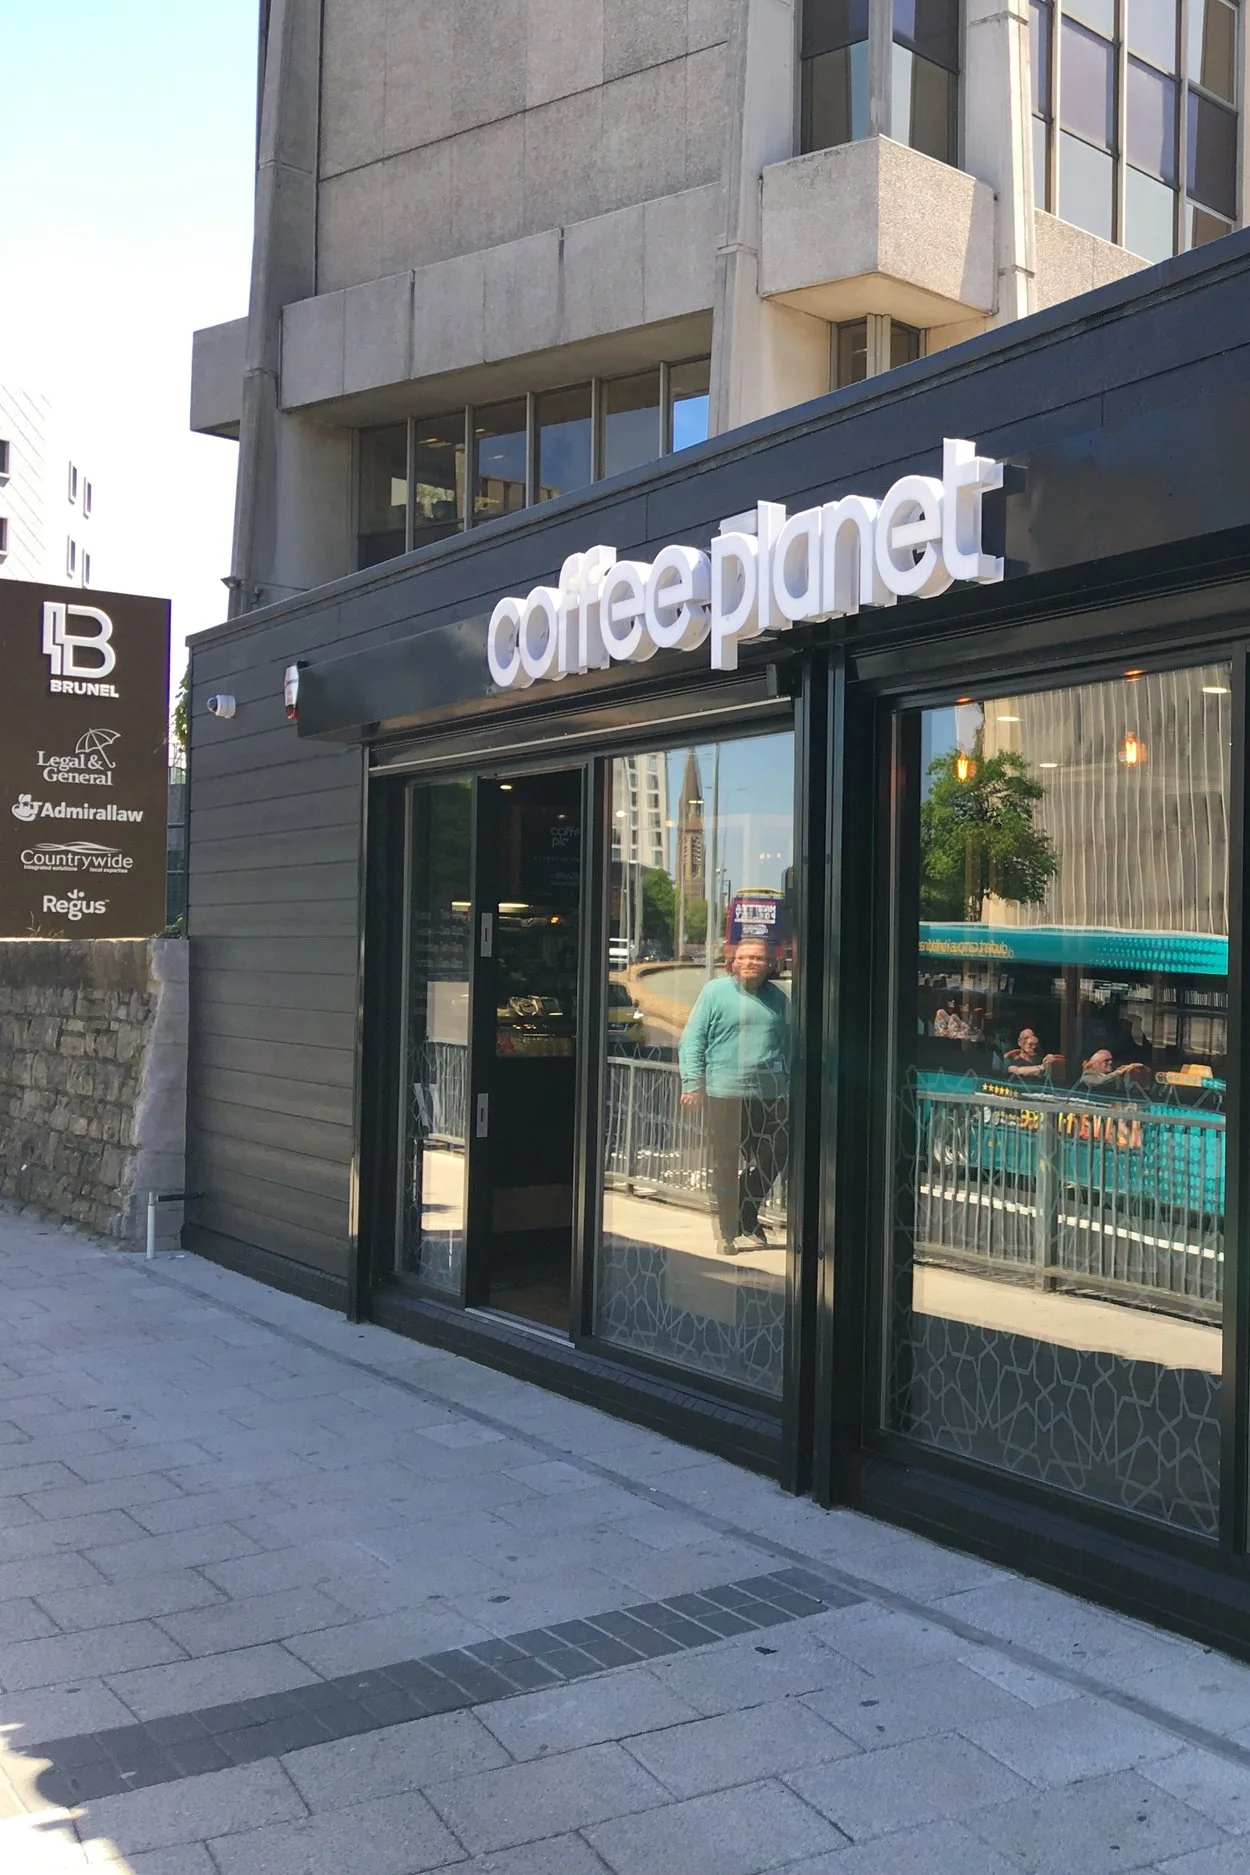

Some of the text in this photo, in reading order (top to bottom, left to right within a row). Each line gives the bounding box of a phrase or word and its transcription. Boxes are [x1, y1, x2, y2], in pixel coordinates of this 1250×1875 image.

[488, 438, 1004, 689] coffee planet
[50, 679, 119, 698] BRUNEL
[37, 750, 104, 771] Legal &
[43, 766, 113, 786] General
[41, 802, 143, 822] Admirallaw
[20, 849, 133, 870] Countrywide
[43, 894, 106, 921] Regus
